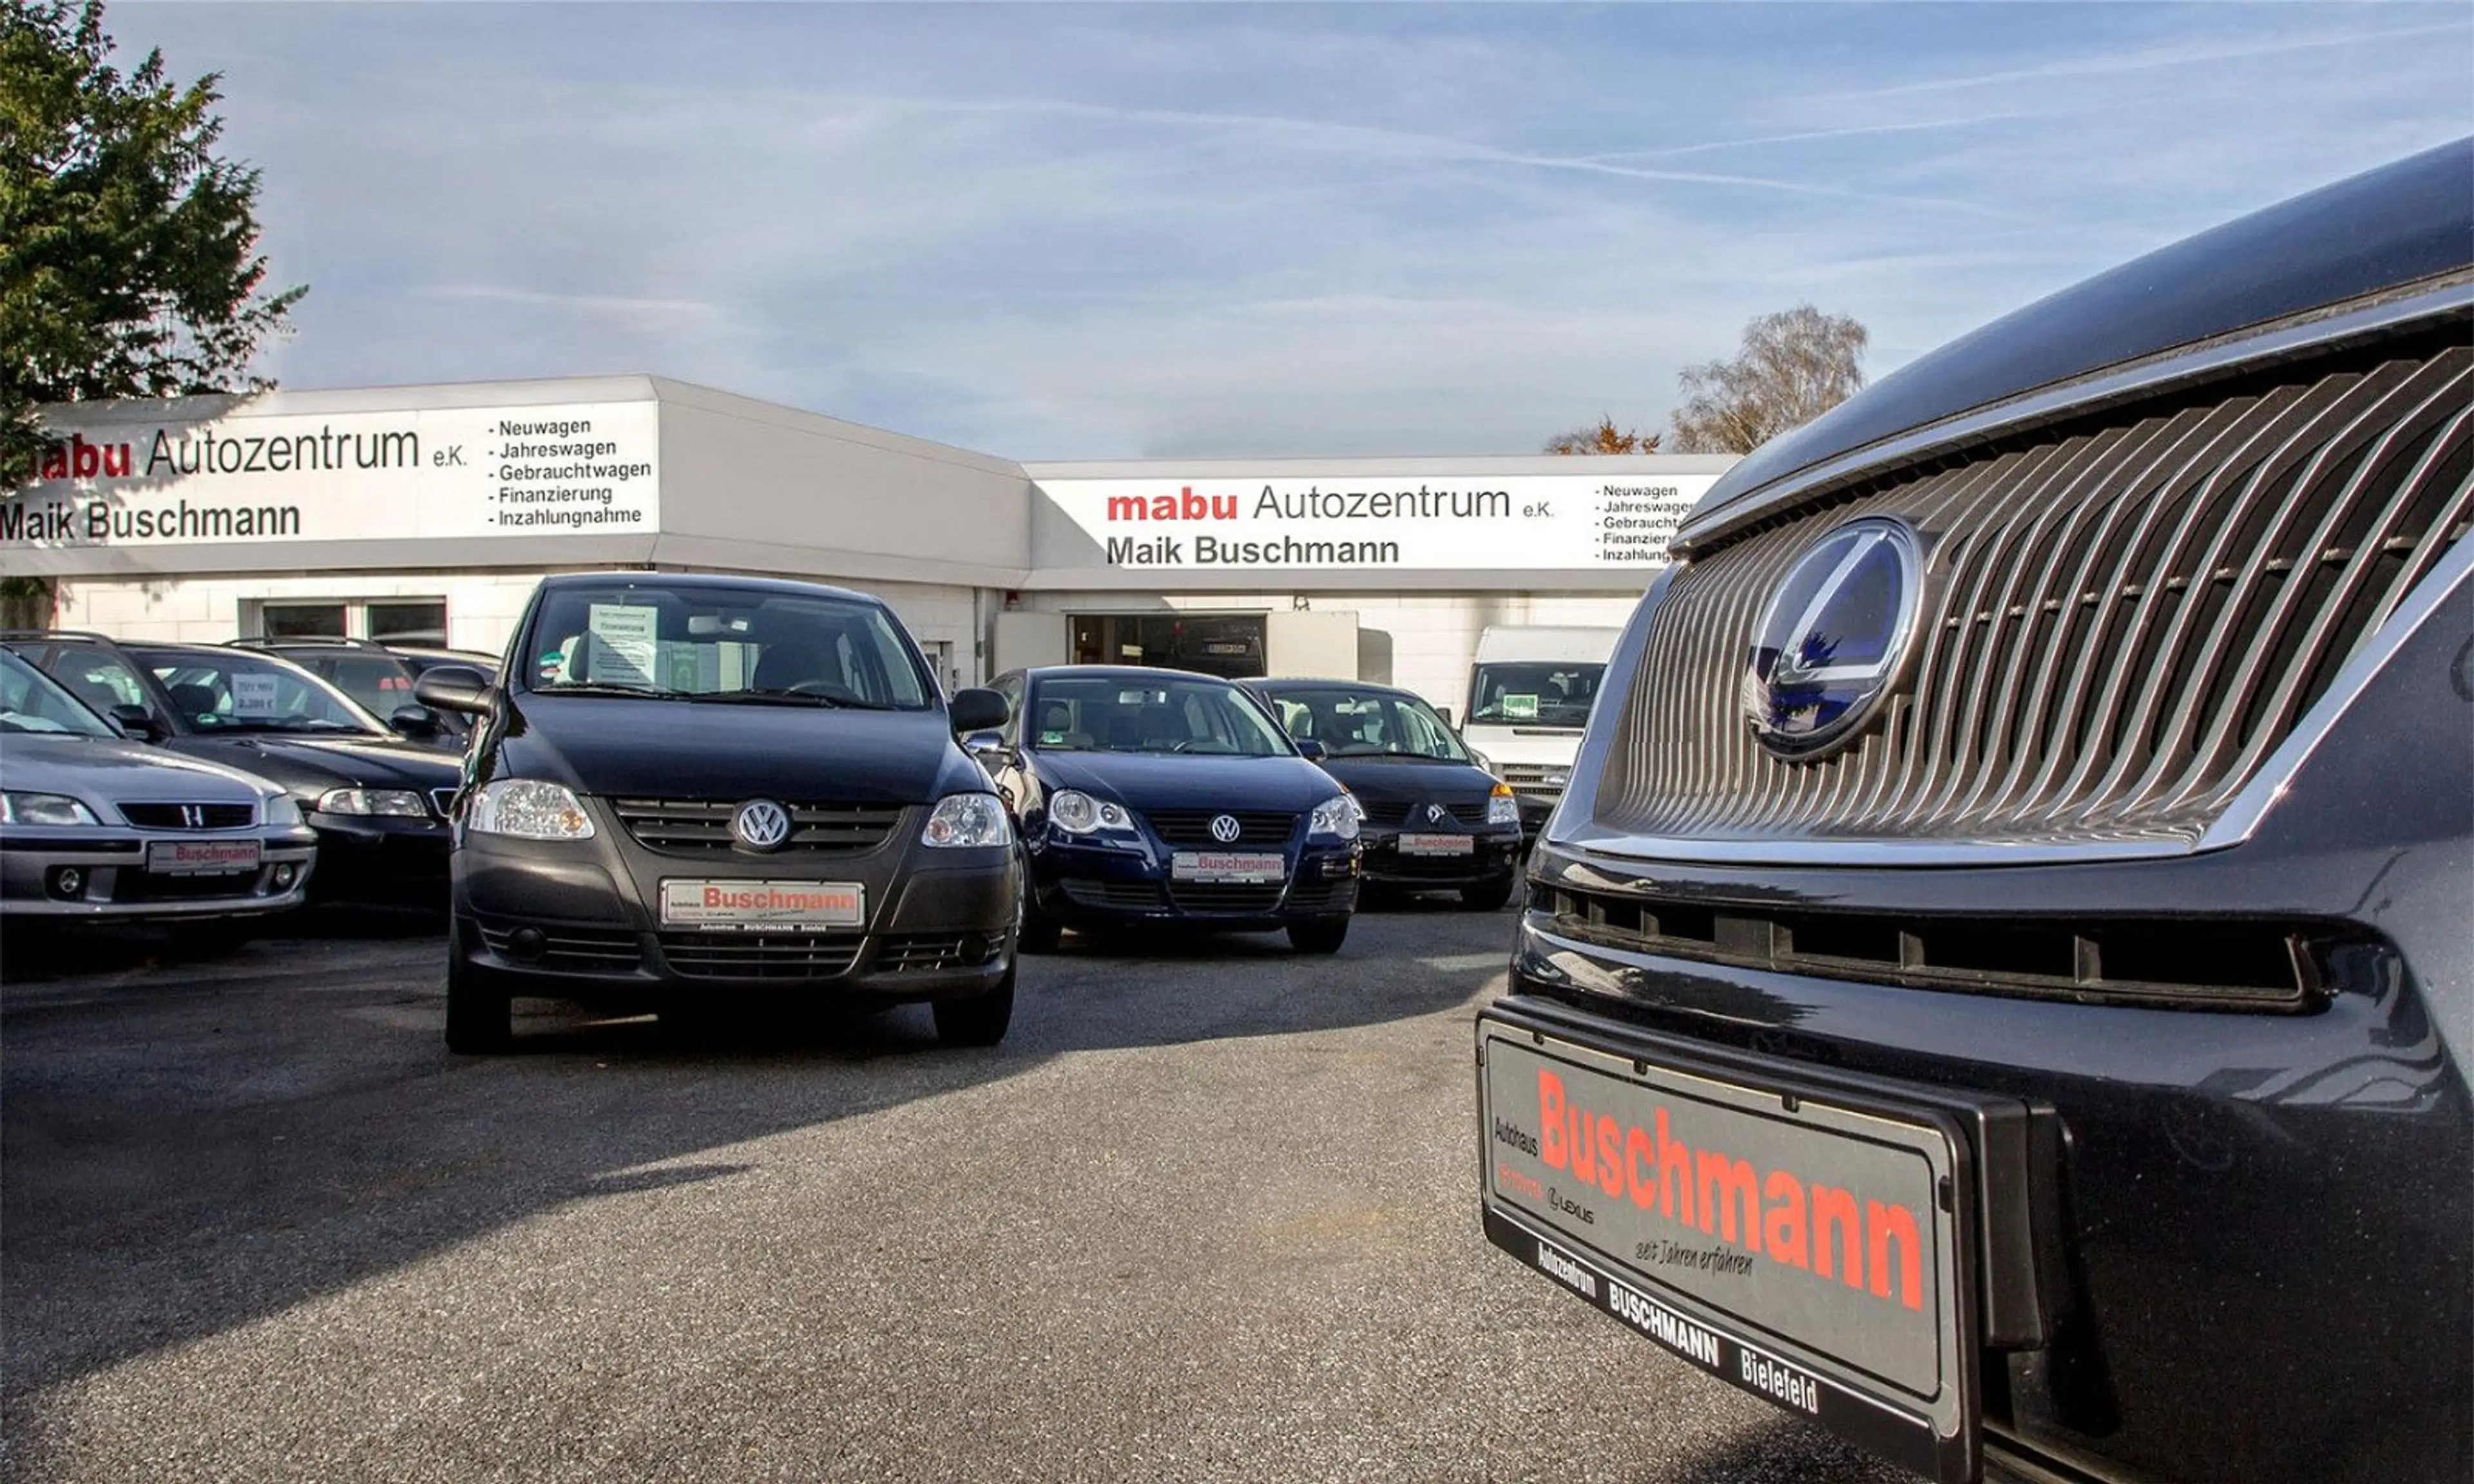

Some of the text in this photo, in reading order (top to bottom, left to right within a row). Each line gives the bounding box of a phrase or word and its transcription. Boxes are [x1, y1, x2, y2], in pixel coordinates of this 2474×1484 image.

[499, 419, 591, 439] Neuwagen
[146, 425, 419, 475] Autozentrum
[433, 445, 468, 468] e.K.
[499, 441, 617, 460] Jahreswagen
[499, 462, 651, 482] Gebrauchtwagen
[499, 486, 613, 505] Finanzierung
[1107, 484, 1555, 521] mabu Autozentrum e.K.
[1603, 485, 1678, 500] Neuwagen
[0, 500, 300, 540] Maik Buschmann
[499, 508, 642, 528] Inzahlungnahme
[1107, 535, 1399, 565] Maik Buschmann
[703, 887, 855, 910] Buschmann
[1538, 1069, 1923, 1311] Buschmann
[1560, 1196, 1595, 1224] LEXUS
[1658, 1239, 1698, 1268] Jahren
[1699, 1245, 1753, 1277] erfahren
[1609, 1281, 1720, 1367] BUSCHMANN
[1740, 1347, 1819, 1415] Bielefeld
